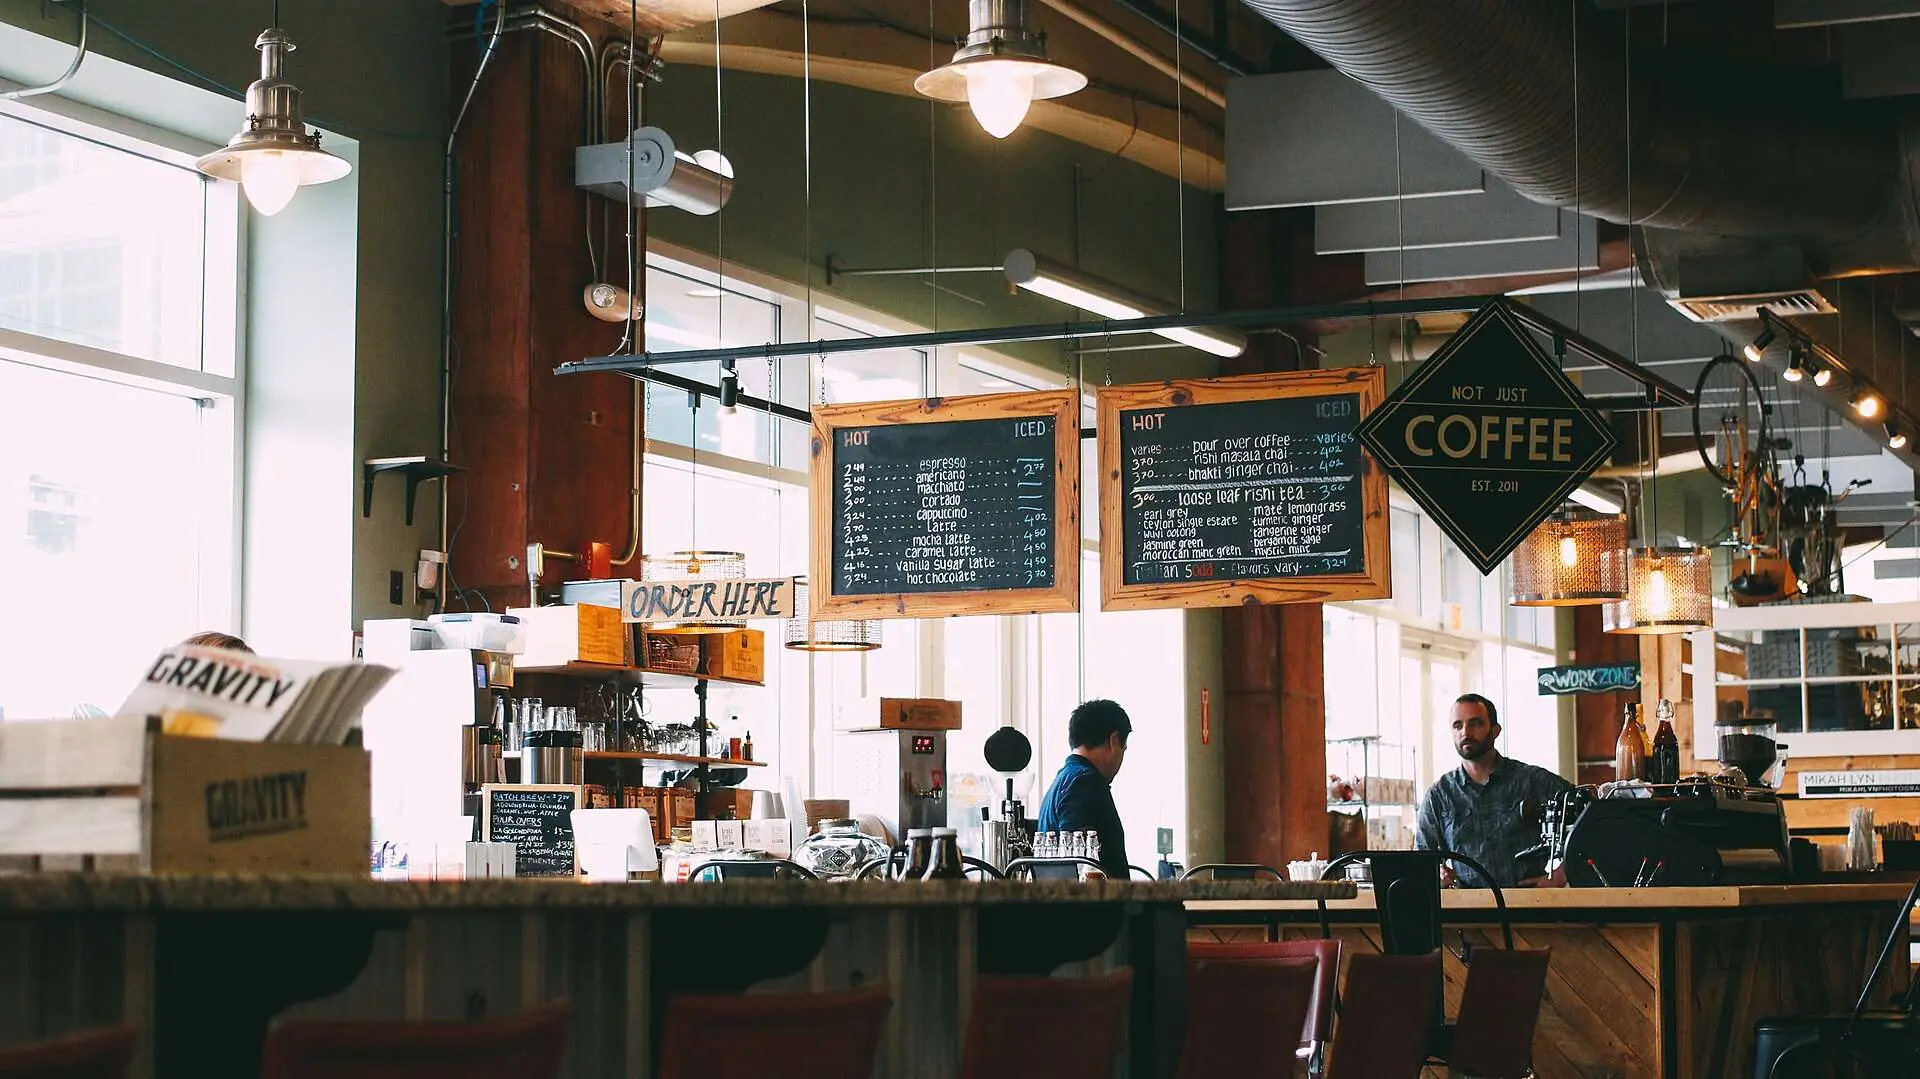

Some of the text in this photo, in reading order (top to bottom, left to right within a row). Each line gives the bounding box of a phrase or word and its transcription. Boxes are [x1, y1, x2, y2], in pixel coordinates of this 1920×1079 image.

[1452, 385, 1528, 403] NOT JUST
[1316, 400, 1351, 418] ICED
[1015, 421, 1046, 438] ICED
[1132, 413, 1166, 431] HOT
[844, 431, 870, 448] HOT
[1131, 431, 1354, 456] varies pour over coffee varies
[1405, 414, 1573, 462] COFFEE
[843, 457, 966, 477] 249 espresso
[1132, 445, 1343, 471] 370 rishi masala chai 402
[843, 463, 1045, 488] 249 americano 277
[1132, 459, 1344, 485] 370 bhakti ginger chai 402
[844, 480, 965, 500] 300 macchiato
[1472, 480, 1519, 493] EST. 2011
[844, 494, 961, 512] 300 cortado
[1132, 483, 1345, 509] 300 loose leaf rishi tea 300
[843, 507, 967, 526] 324 cappuccino
[1144, 508, 1189, 520] earl grey
[1288, 501, 1346, 515] lemongrass
[843, 513, 1048, 537] 370 latte 402
[1143, 515, 1239, 530] ceylon single estate
[1252, 514, 1324, 527] turmeric ginger
[844, 529, 1047, 547] 425 mocha latte 450
[1166, 527, 1196, 538] oolong
[1253, 524, 1333, 538] tangerine ginger
[1142, 538, 1204, 552] jasmine green
[1254, 535, 1321, 547] bergamot sage
[844, 543, 1047, 559] 425 caramel latte 450
[1142, 545, 1242, 560] moroccan mint green
[1255, 545, 1311, 557] mystic mint
[843, 556, 1047, 572] 416 vanilla sugar latte 450
[1274, 562, 1299, 576] vary
[1321, 558, 1346, 570] 324
[844, 570, 1047, 588] 324 hot chocolate 370
[630, 581, 785, 618] ORDER HERE
[146, 653, 294, 708] GRAVITY
[1553, 666, 1635, 688] WORK ZONE
[1804, 774, 1846, 785] MIKAH
[1851, 773, 1875, 784] LYN
[205, 770, 309, 829] GRAVITY
